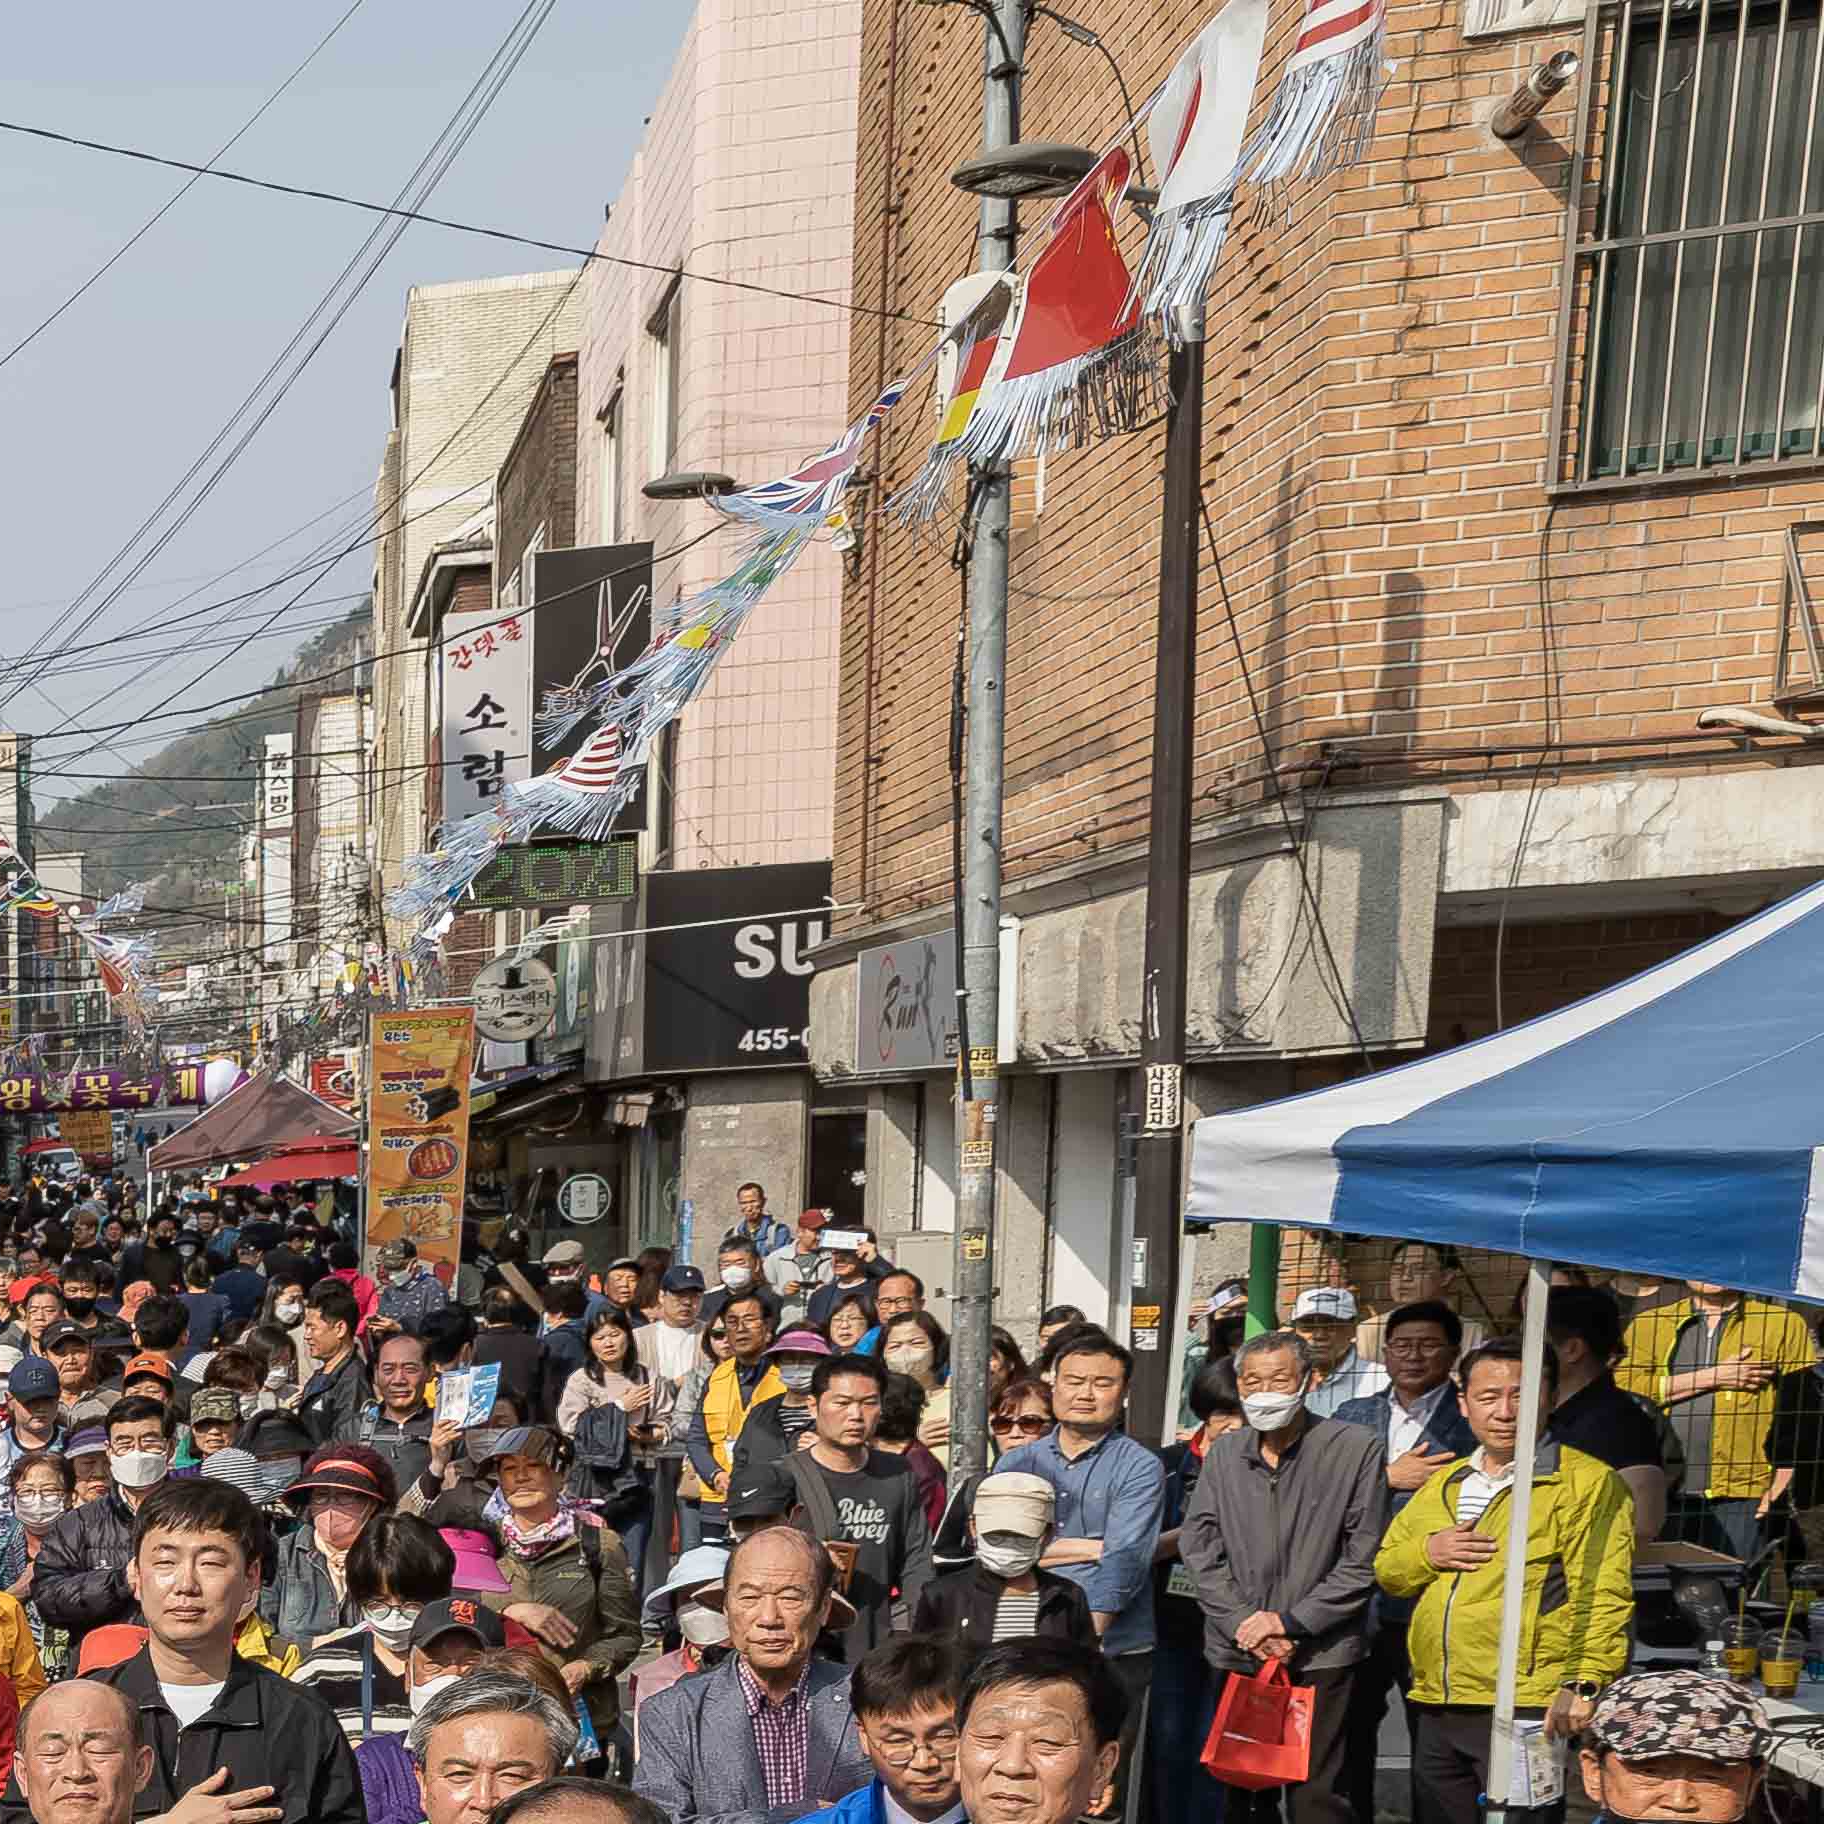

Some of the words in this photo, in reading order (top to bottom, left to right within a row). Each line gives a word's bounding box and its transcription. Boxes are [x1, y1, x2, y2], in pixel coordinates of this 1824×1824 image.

[459, 692, 509, 818] 소림
[737, 1027, 811, 1053] 455-
[837, 1497, 886, 1525] Blue
